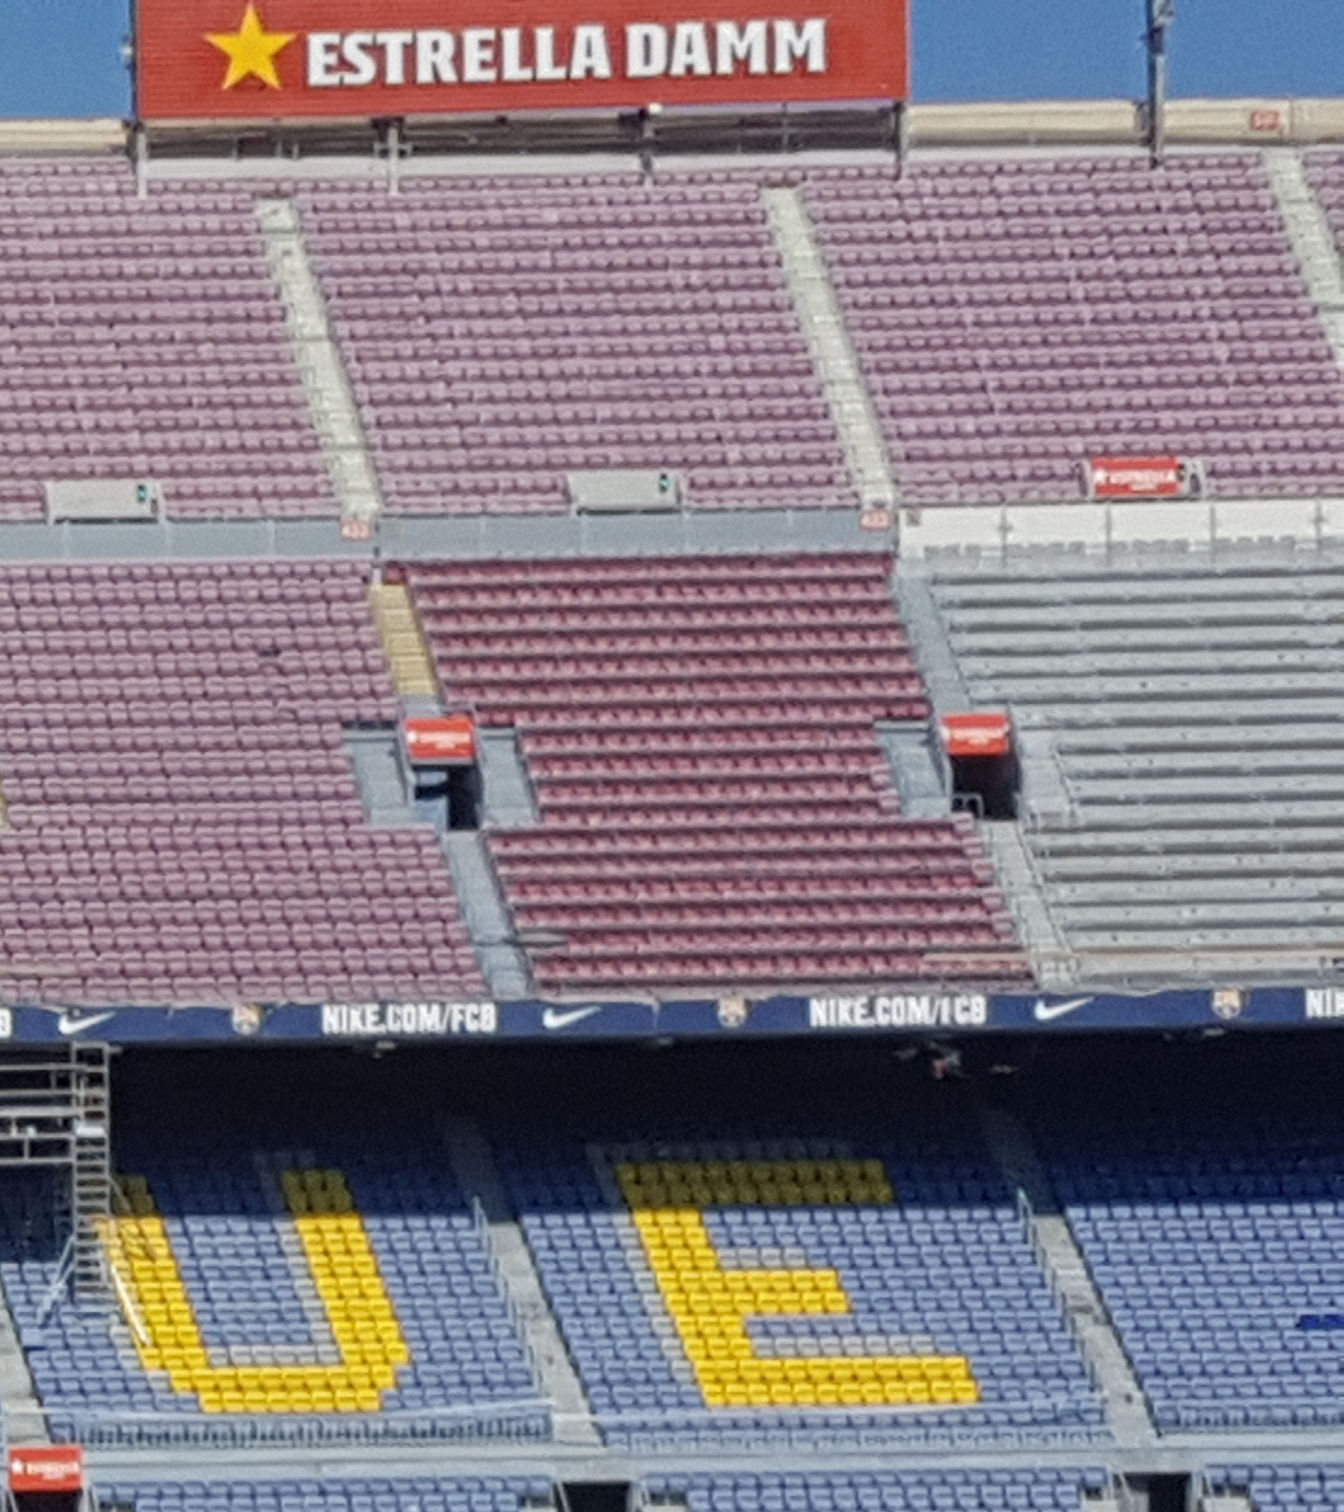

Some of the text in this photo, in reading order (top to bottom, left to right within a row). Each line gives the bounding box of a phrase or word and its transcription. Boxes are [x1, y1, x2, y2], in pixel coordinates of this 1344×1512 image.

[308, 18, 826, 87] ESTRELLA DAMM
[322, 1003, 496, 1034] NIKE.COM/FCB
